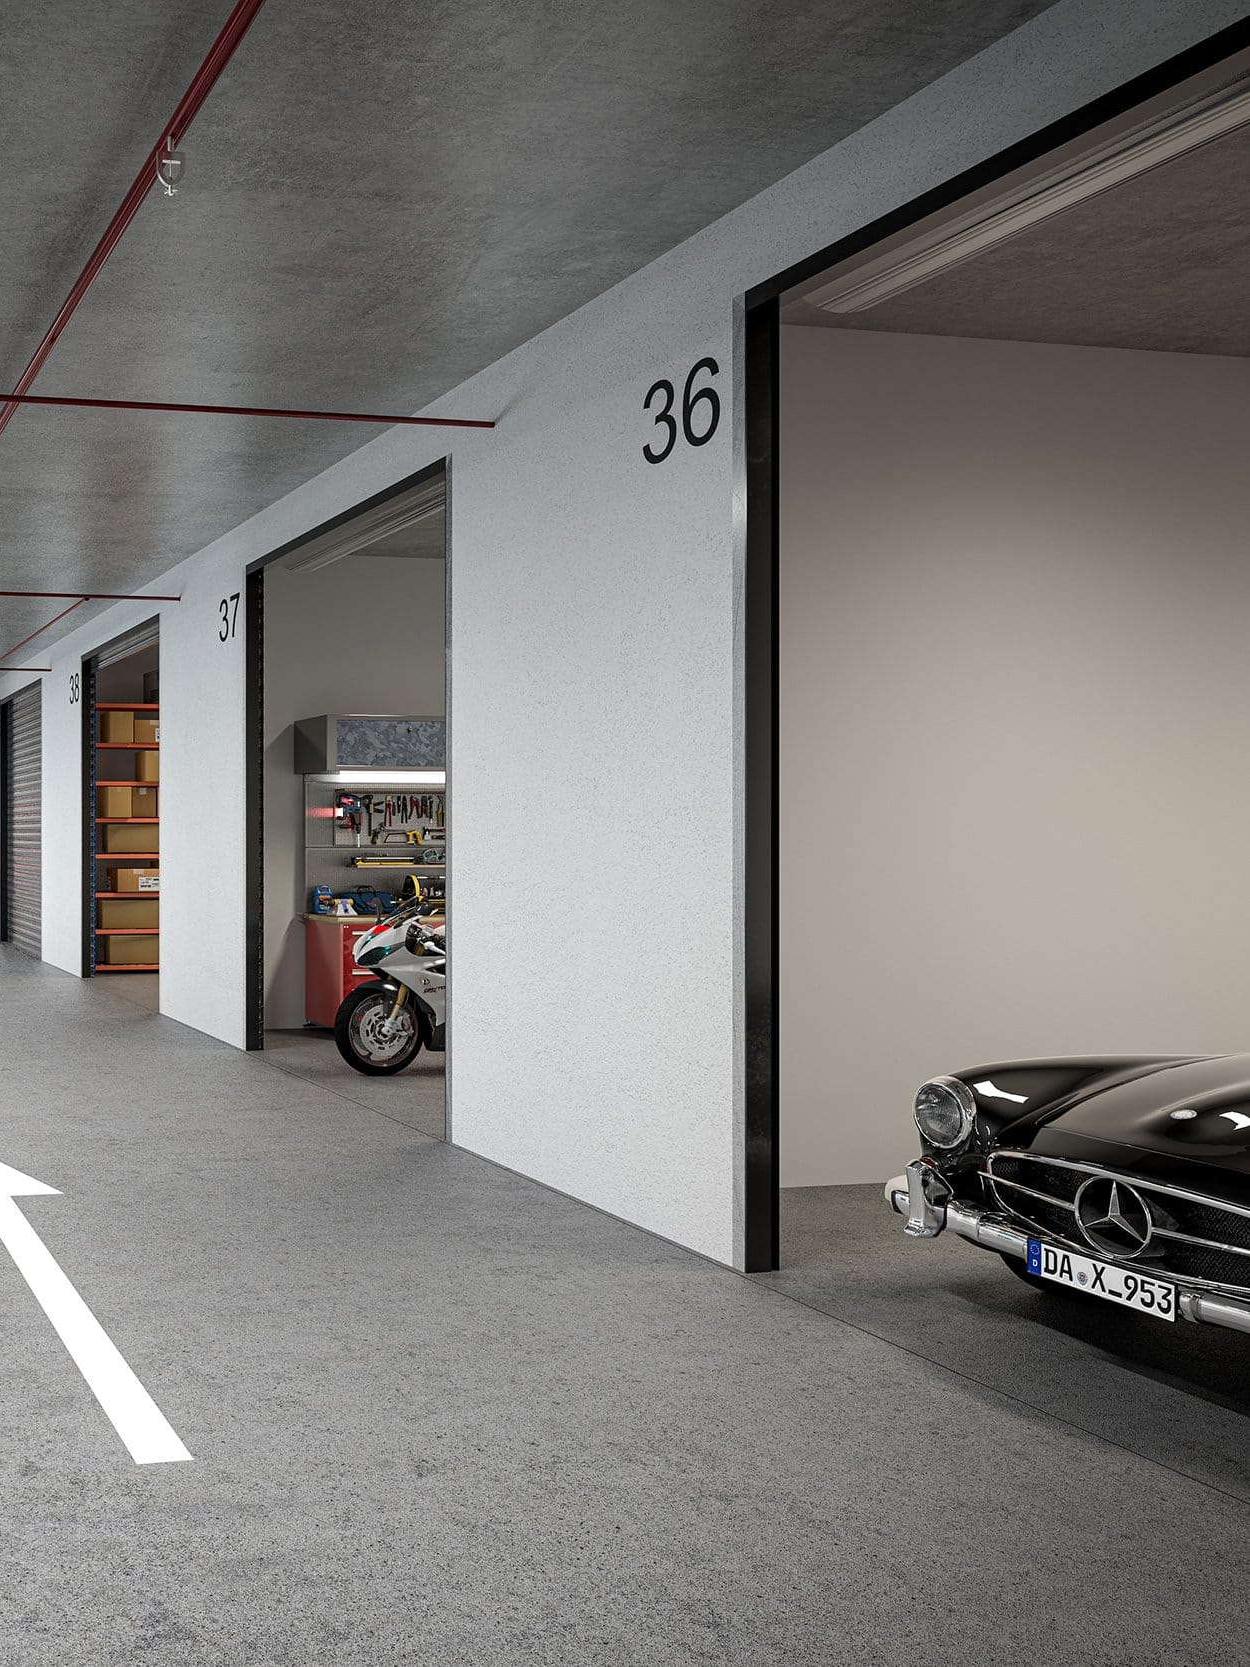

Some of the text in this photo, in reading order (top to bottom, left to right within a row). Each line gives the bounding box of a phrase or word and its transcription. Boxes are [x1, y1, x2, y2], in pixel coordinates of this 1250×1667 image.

[642, 356, 721, 465] 36
[218, 591, 241, 643] 37
[69, 672, 80, 705] 38
[1032, 1258, 1038, 1267] D
[1043, 1247, 1073, 1282] DA
